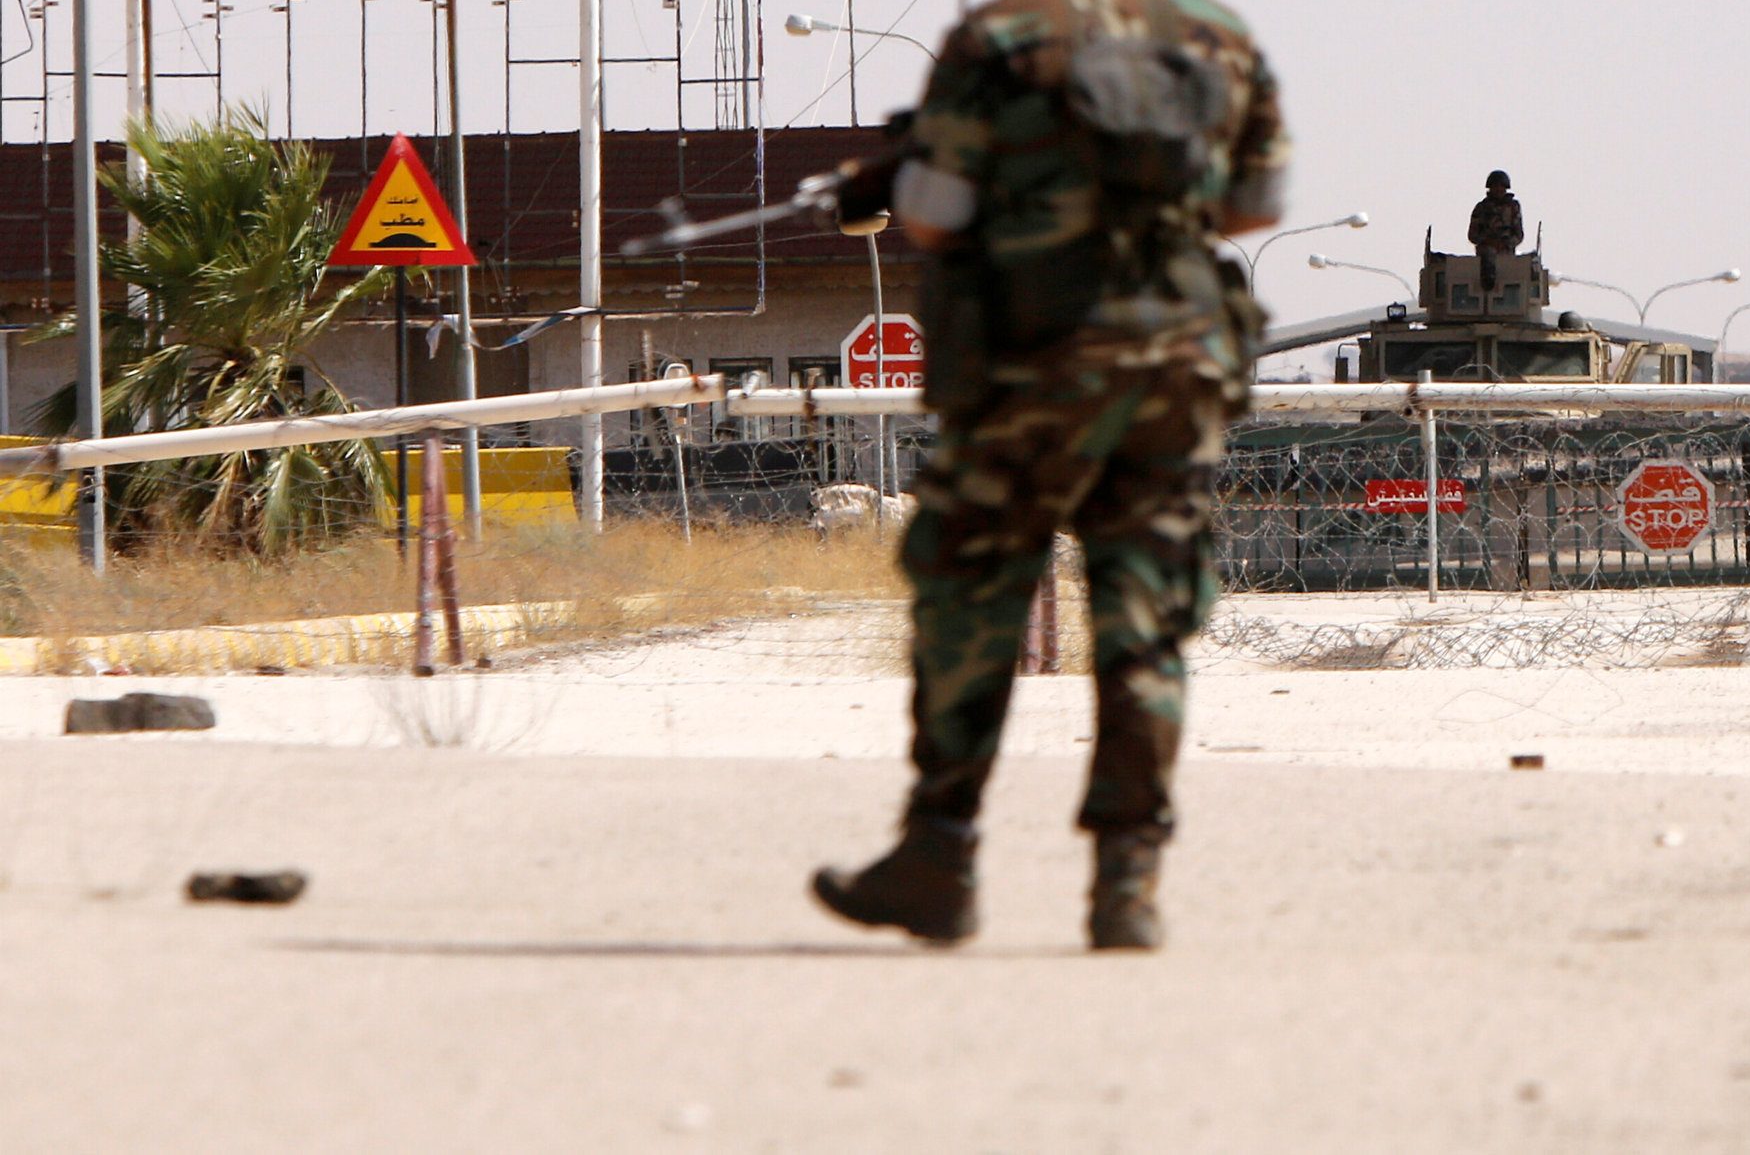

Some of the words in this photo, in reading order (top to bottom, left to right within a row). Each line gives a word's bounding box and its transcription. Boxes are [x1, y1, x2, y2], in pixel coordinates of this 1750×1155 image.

[851, 332, 924, 361] قف
[859, 372, 925, 388] STOP
[1367, 488, 1429, 507] لتفتيش
[1629, 478, 1701, 503] قف
[1629, 508, 1705, 532] STOP
